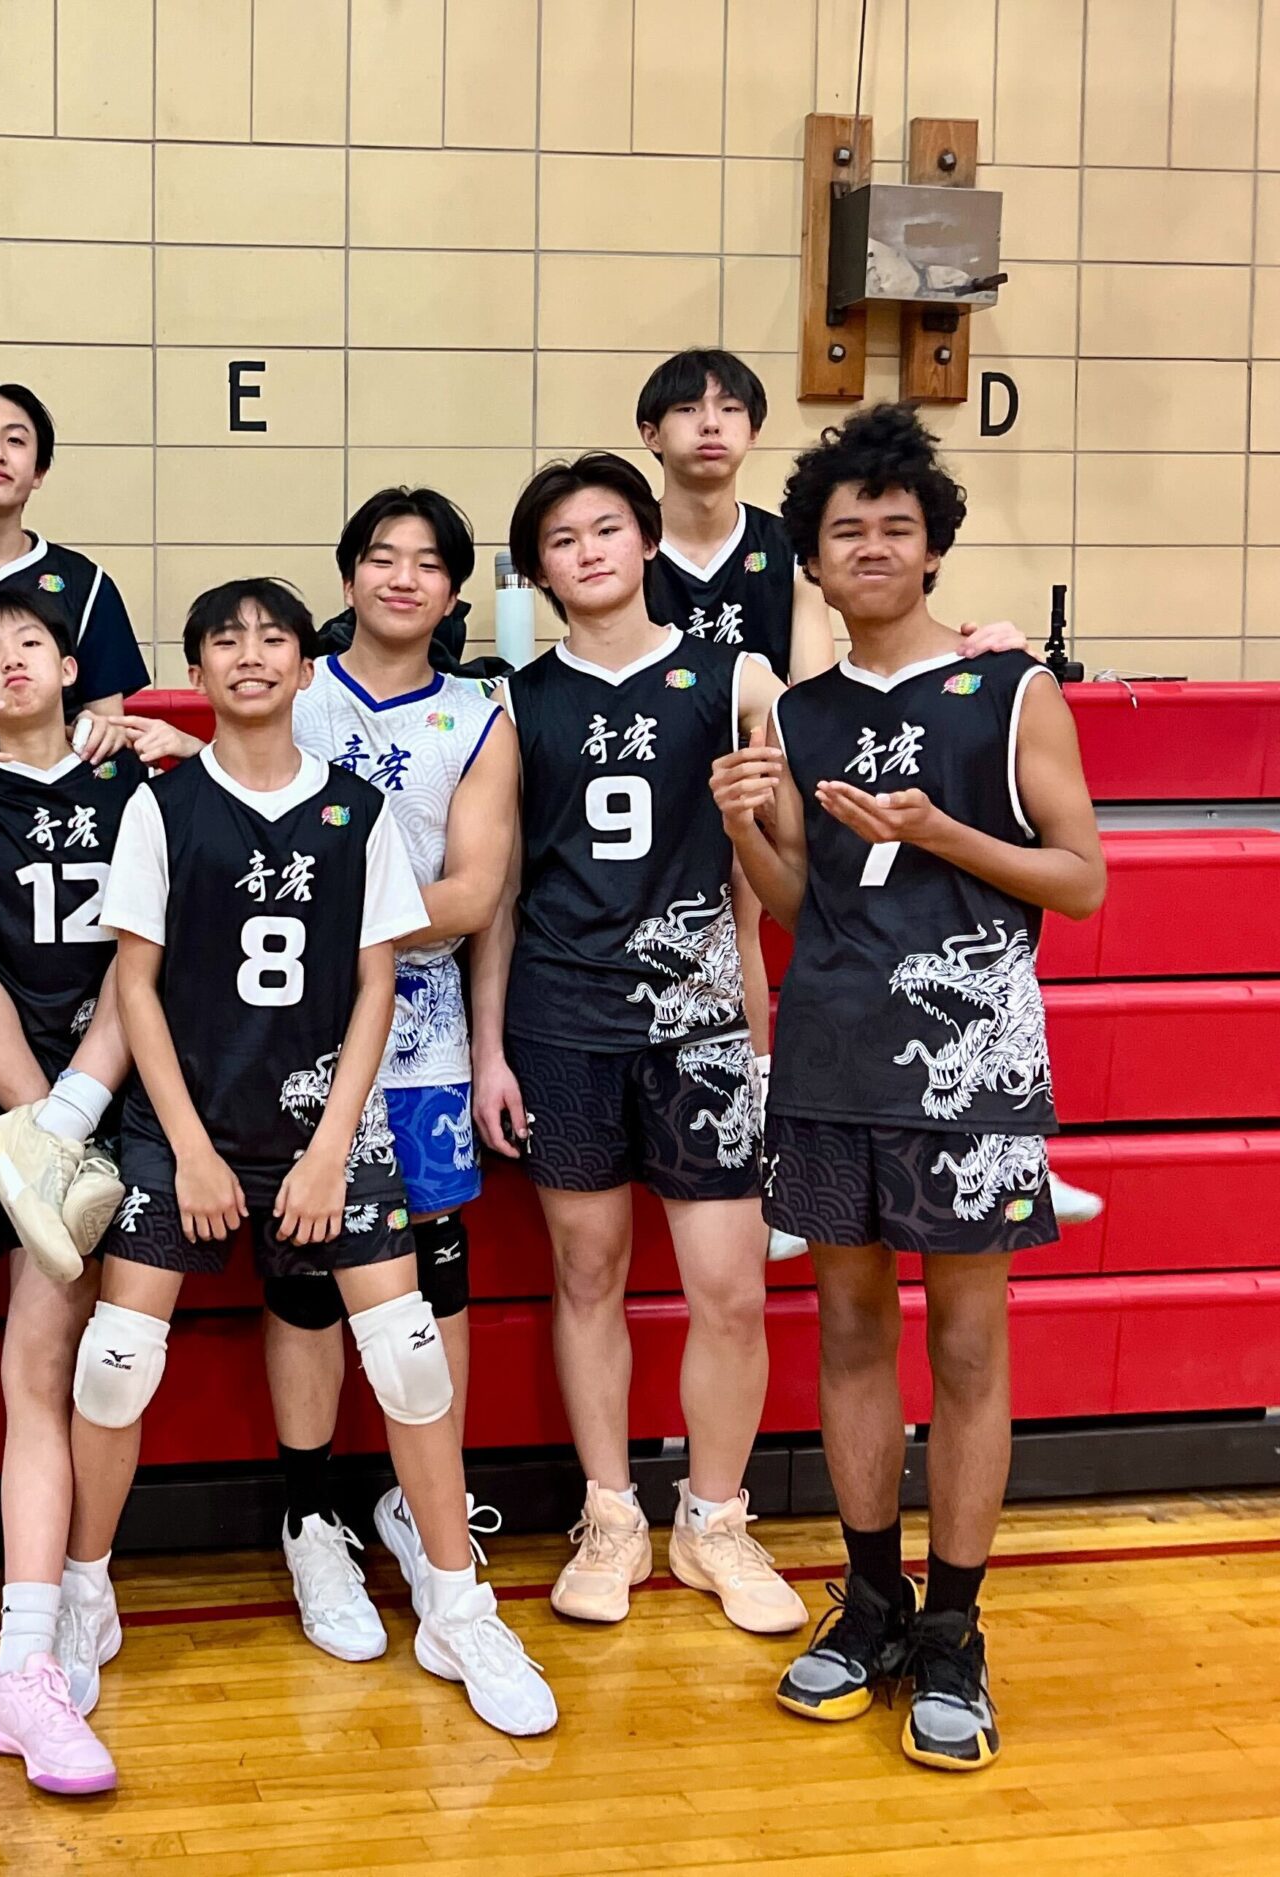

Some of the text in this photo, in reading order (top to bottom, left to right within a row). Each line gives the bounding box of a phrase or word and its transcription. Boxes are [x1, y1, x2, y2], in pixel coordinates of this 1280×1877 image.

[229, 361, 267, 431] E
[981, 372, 1019, 436] D
[585, 775, 652, 860] 9
[15, 862, 119, 944] 12
[236, 915, 307, 1007] 8
